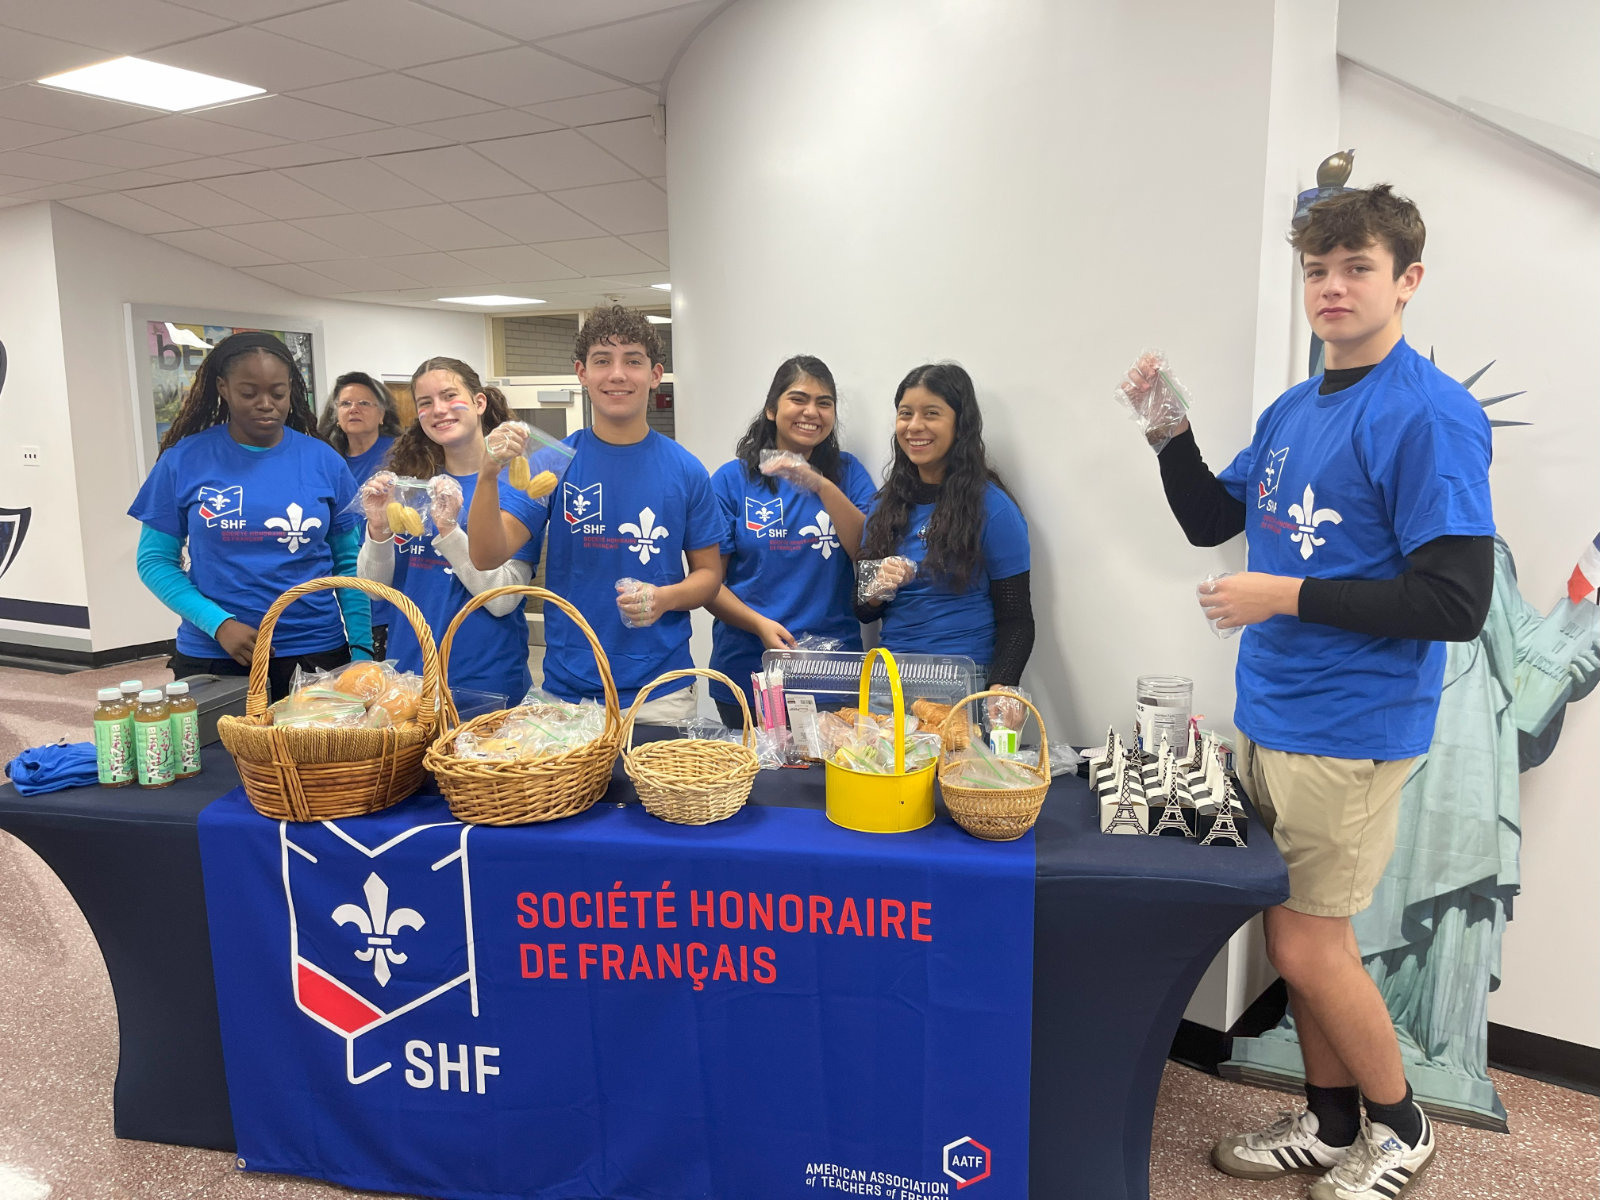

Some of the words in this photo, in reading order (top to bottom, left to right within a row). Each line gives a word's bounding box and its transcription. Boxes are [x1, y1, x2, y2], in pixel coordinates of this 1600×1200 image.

[220, 519, 247, 530] SHF
[583, 524, 607, 535] SHF
[768, 528, 789, 538] SHF
[517, 881, 677, 929] SOCIÉTÉ
[690, 890, 932, 942] HONORAIRE
[520, 943, 568, 979] DE
[578, 942, 777, 991] FRANÇAIS
[405, 1040, 500, 1095] SHF
[952, 1155, 982, 1168] AATF
[806, 1163, 866, 1182] AMERICAN
[870, 1171, 948, 1195] ASSOCIATION
[806, 1176, 816, 1188] of
[820, 1176, 881, 1196] TEACHERS
[886, 1189, 896, 1199] of
